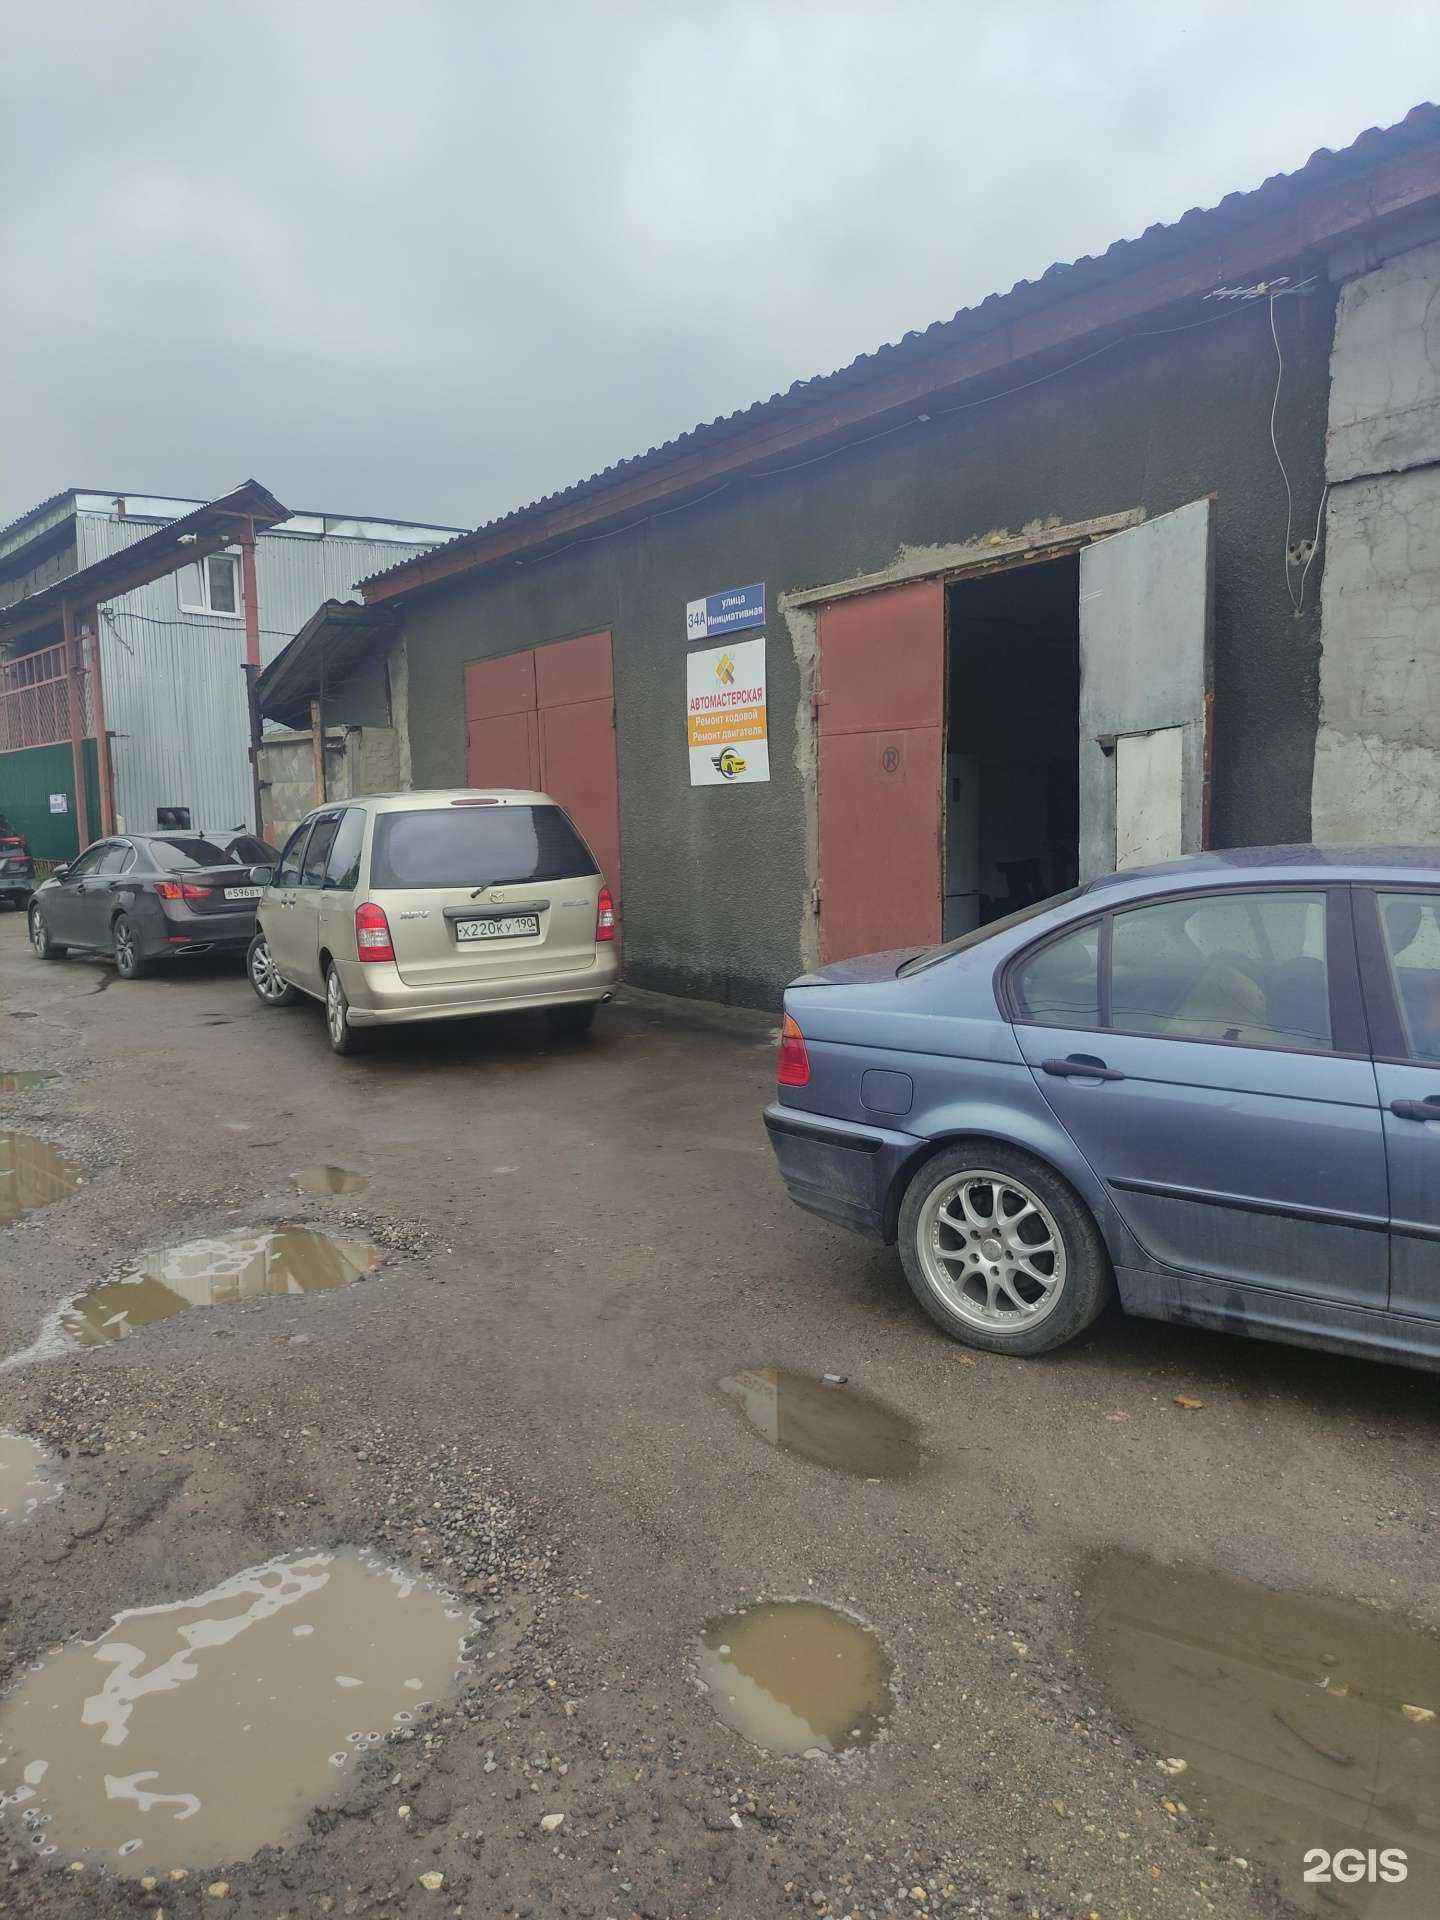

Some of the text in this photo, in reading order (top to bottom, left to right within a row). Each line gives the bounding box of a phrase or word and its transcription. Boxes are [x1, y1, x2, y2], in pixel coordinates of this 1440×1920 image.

[721, 594, 746, 610] улица
[707, 606, 763, 627] Инициативная
[690, 687, 763, 711] АВТОМАСТЕРСКАЯ
[695, 715, 723, 727] Ремонт
[692, 731, 721, 742] Ремонт
